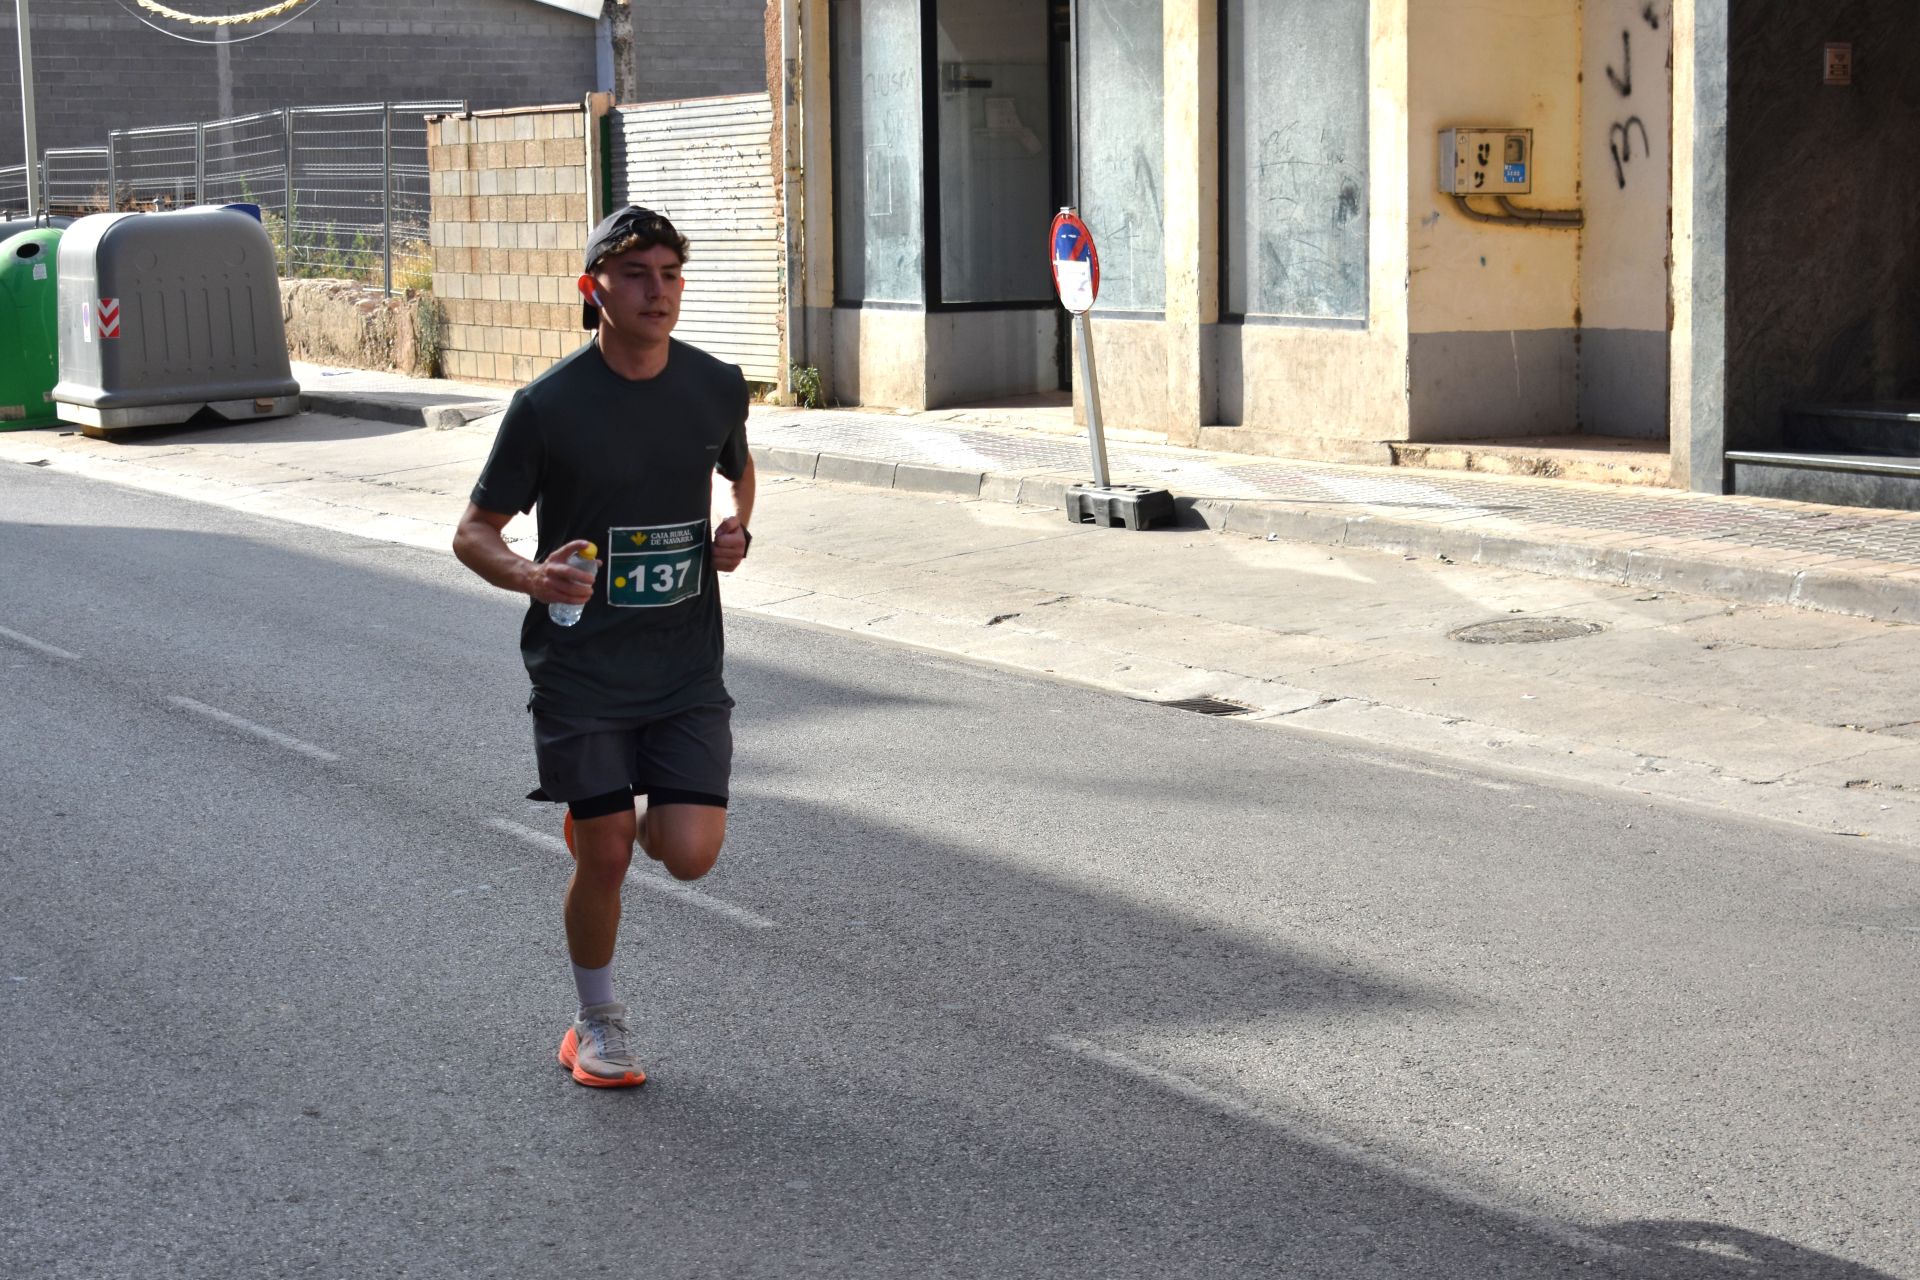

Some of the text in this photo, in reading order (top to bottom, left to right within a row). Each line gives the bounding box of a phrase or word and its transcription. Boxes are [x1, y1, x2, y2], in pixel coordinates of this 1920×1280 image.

[669, 529, 692, 538] RURAL
[663, 535, 694, 545] NAVARRA
[628, 559, 692, 593] 137
